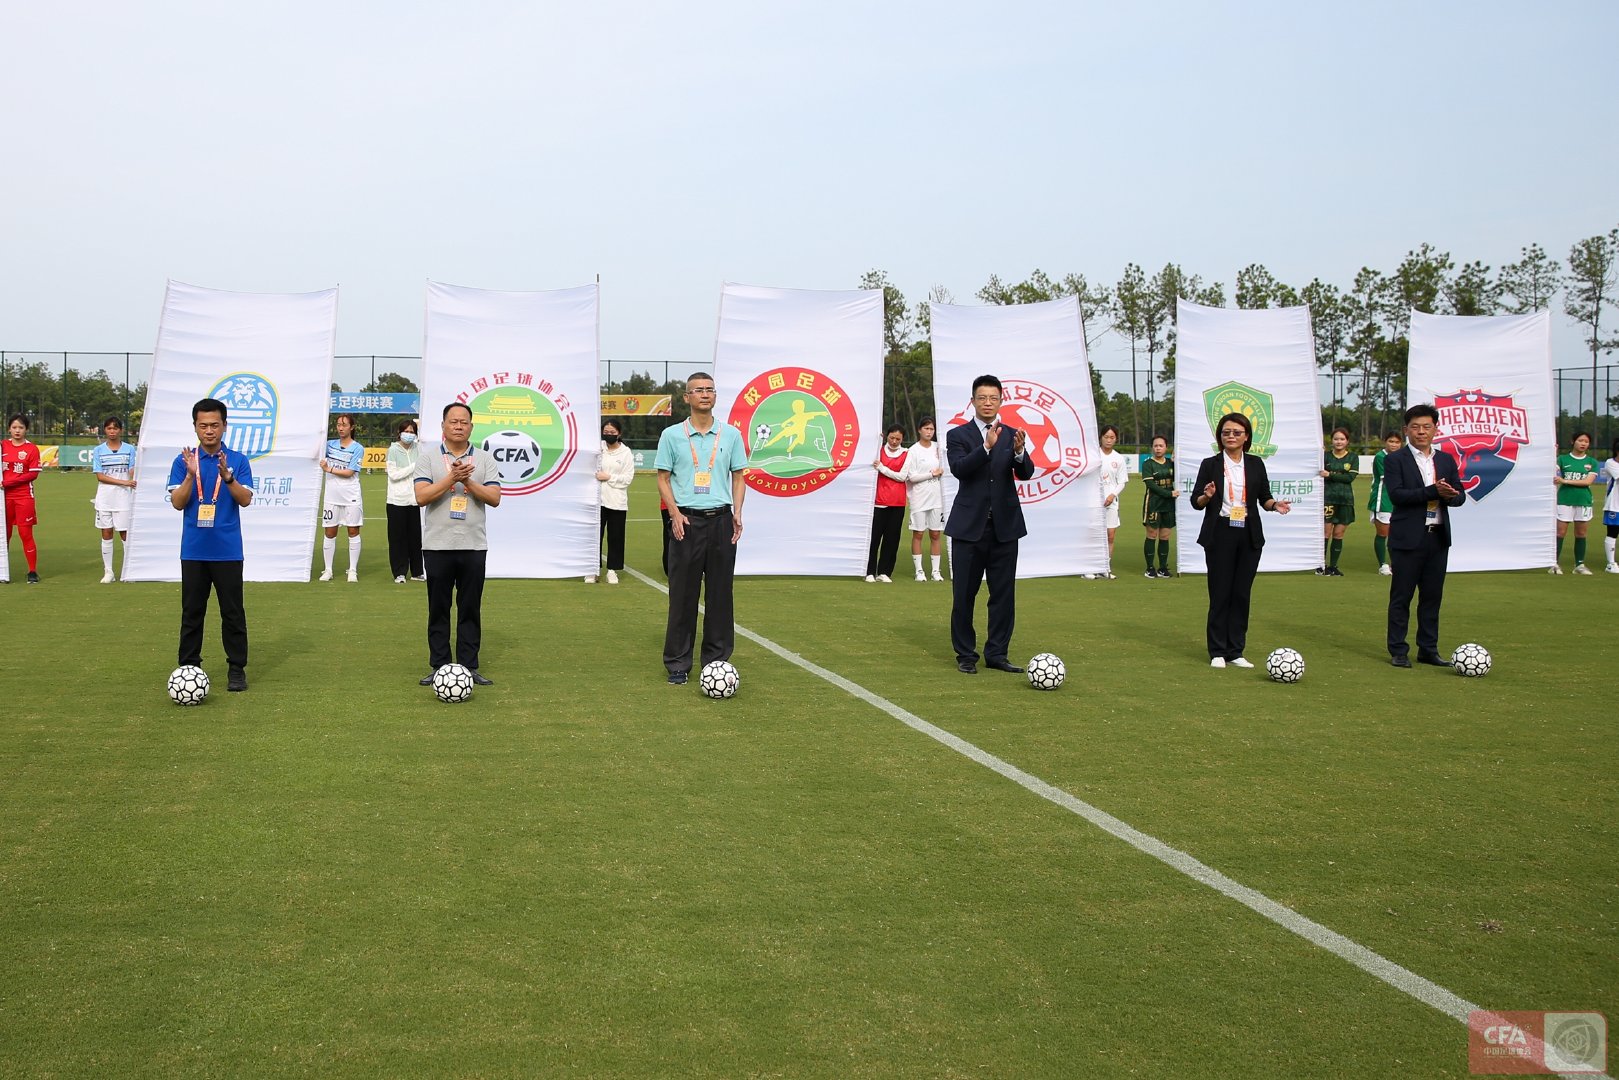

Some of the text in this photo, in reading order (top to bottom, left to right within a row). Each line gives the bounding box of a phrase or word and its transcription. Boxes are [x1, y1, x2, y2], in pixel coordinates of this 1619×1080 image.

[743, 372, 842, 407] 校园足球
[492, 447, 531, 463] CFA
[1050, 447, 1082, 486] CLUB
[274, 497, 290, 506] FC
[323, 510, 334, 520] 20
